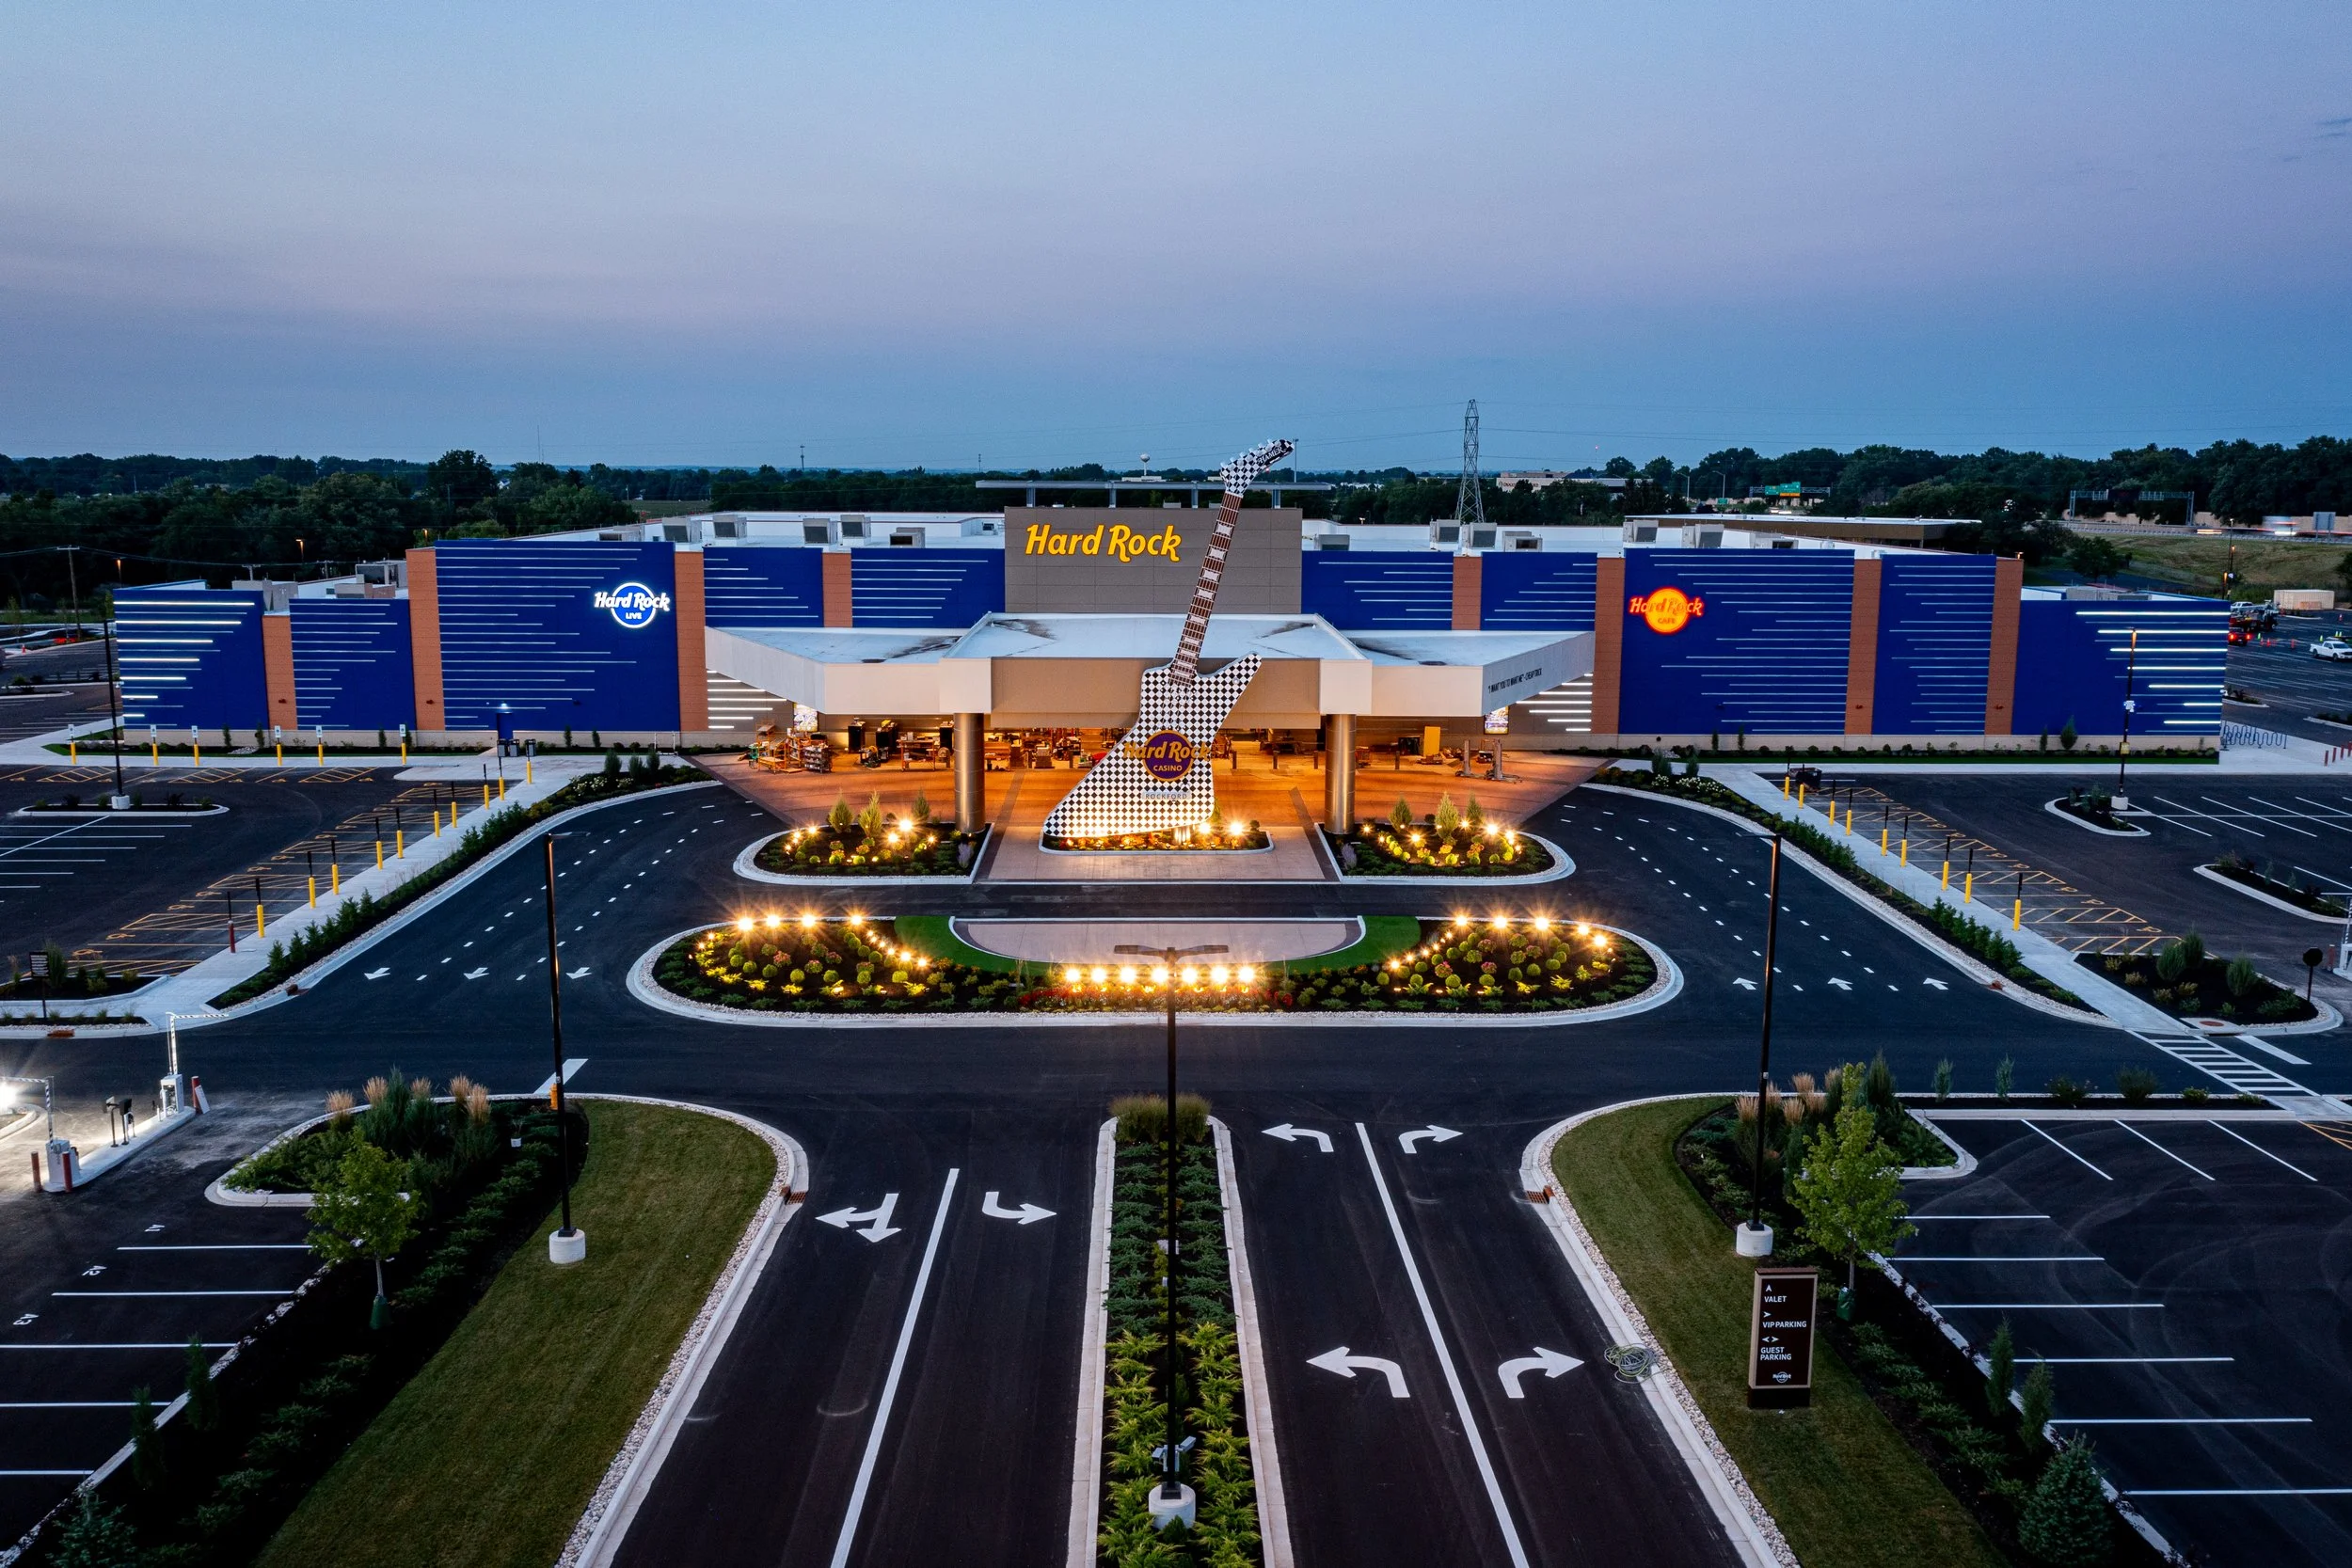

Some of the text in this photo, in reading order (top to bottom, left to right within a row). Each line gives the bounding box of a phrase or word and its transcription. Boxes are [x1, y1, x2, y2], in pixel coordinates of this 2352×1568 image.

[1025, 524, 1182, 562] Hard Rock
[594, 592, 671, 612] Hard Rock
[1629, 596, 1704, 616] Hard Rock
[1123, 741, 1211, 763] Hard Rock
[81, 1264, 108, 1276] A2
[12, 1313, 40, 1326] A3
